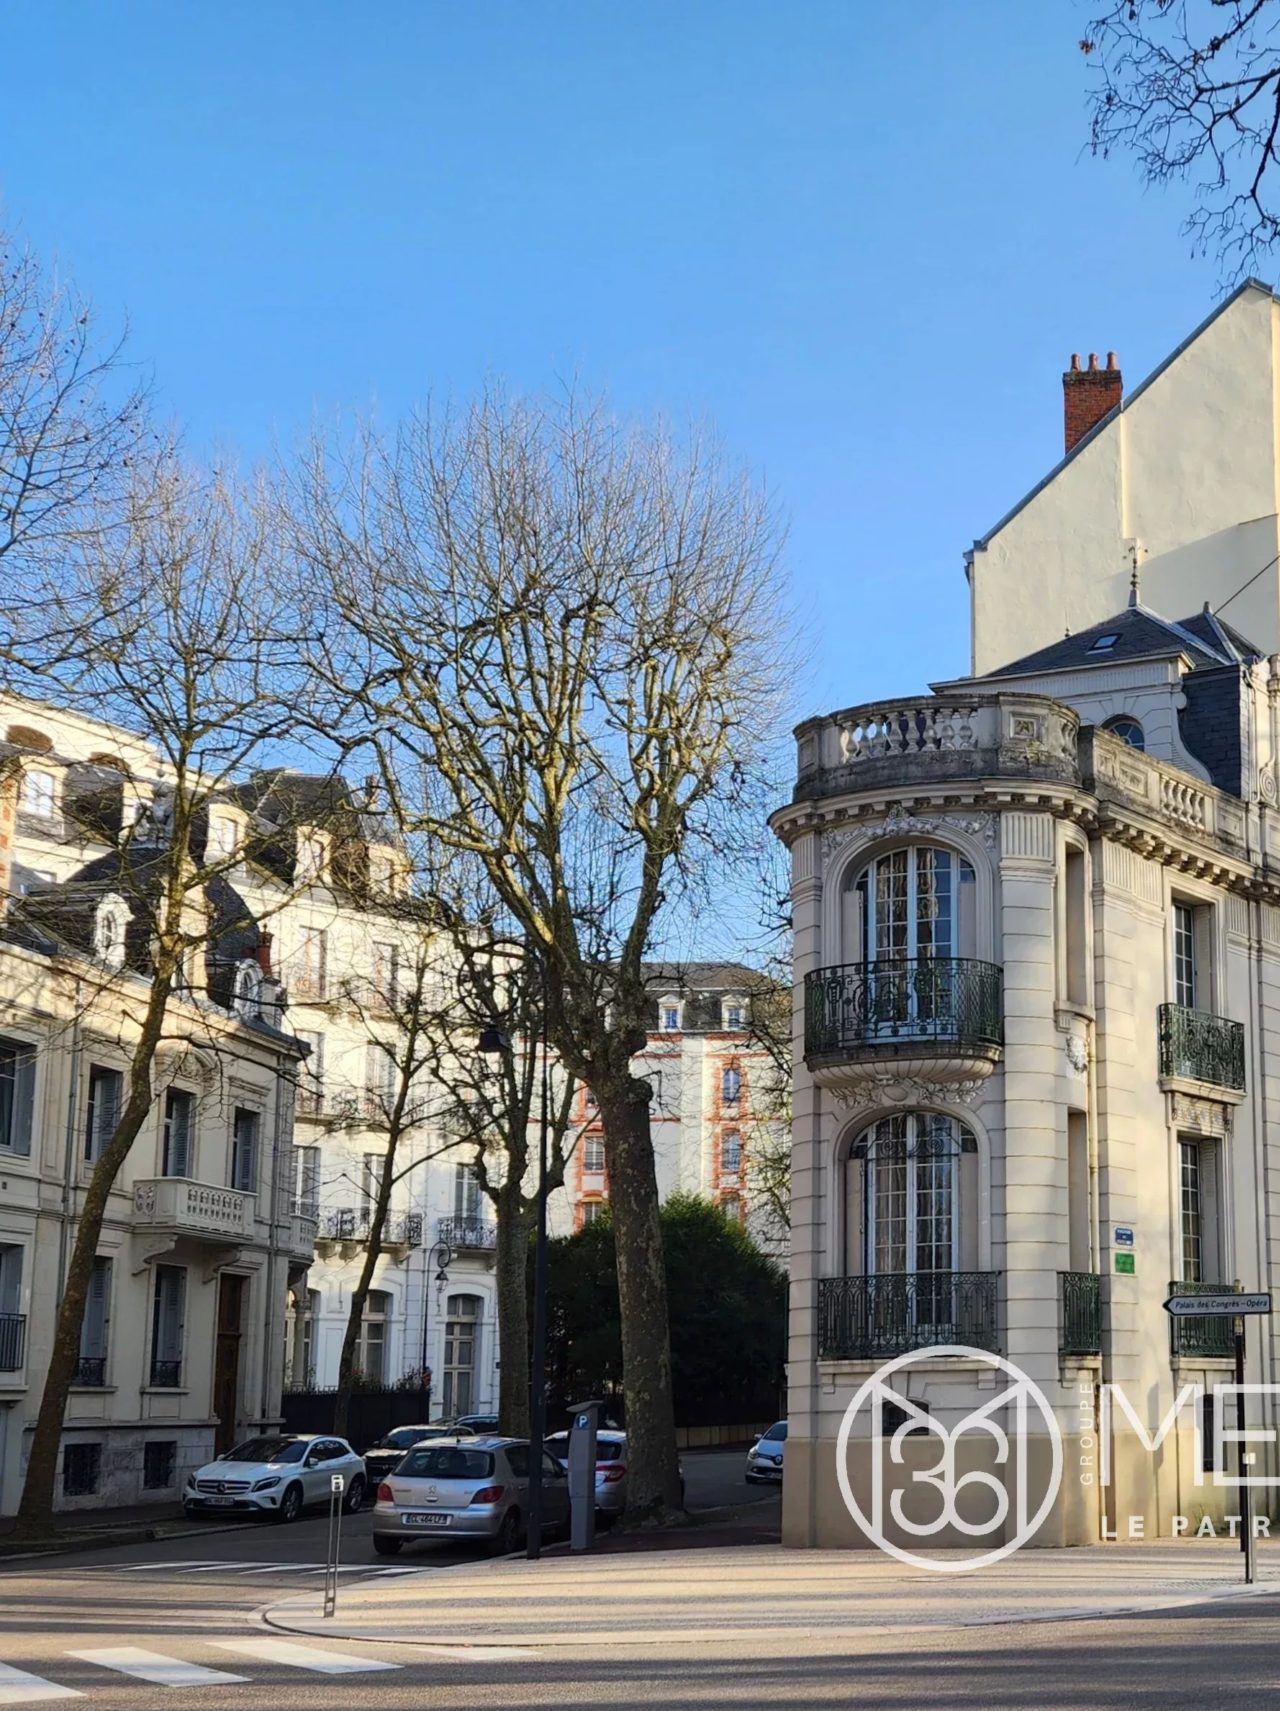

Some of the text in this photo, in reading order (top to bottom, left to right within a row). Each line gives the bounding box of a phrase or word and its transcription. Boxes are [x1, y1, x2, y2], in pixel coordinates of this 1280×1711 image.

[1175, 1301, 1195, 1309] Palais
[1198, 1301, 1209, 1309] des
[1211, 1300, 1239, 1310] Congrès
[1246, 1299, 1267, 1309] Opéra
[579, 1415, 588, 1427] P
